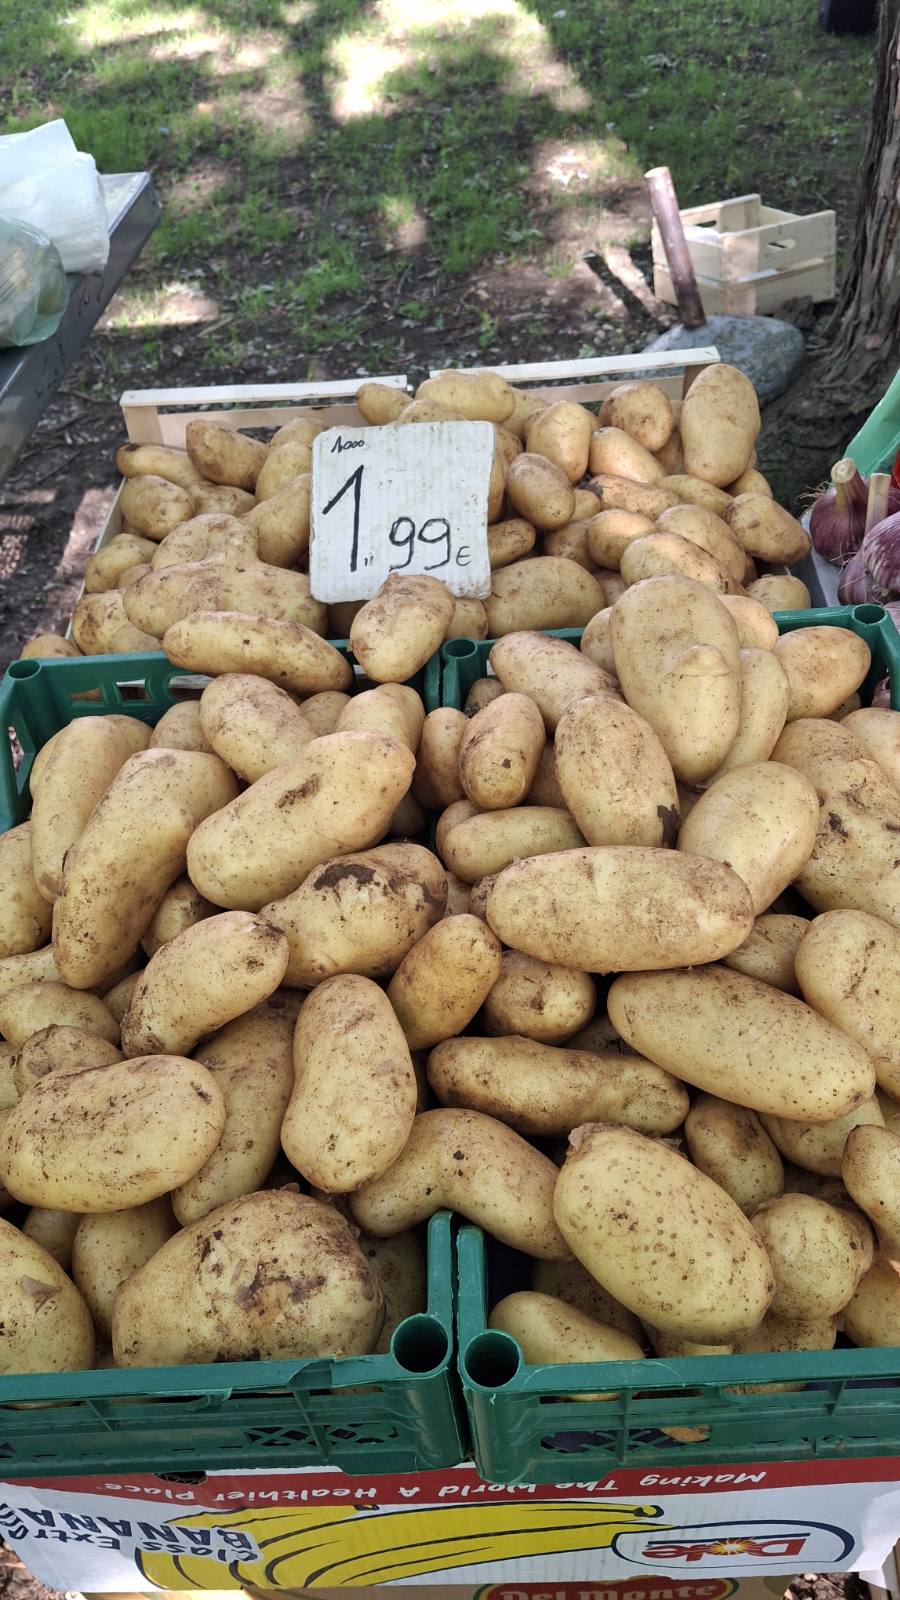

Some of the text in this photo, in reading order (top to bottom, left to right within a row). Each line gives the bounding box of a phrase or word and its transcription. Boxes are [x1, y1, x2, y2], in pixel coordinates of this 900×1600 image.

[639, 1471, 767, 1488] Making
[104, 1482, 195, 1500] Place
[213, 1485, 377, 1502] Healthier
[397, 1486, 421, 1498] A
[8, 1526, 259, 1561] Class Extra
[641, 1537, 807, 1562] Dole
